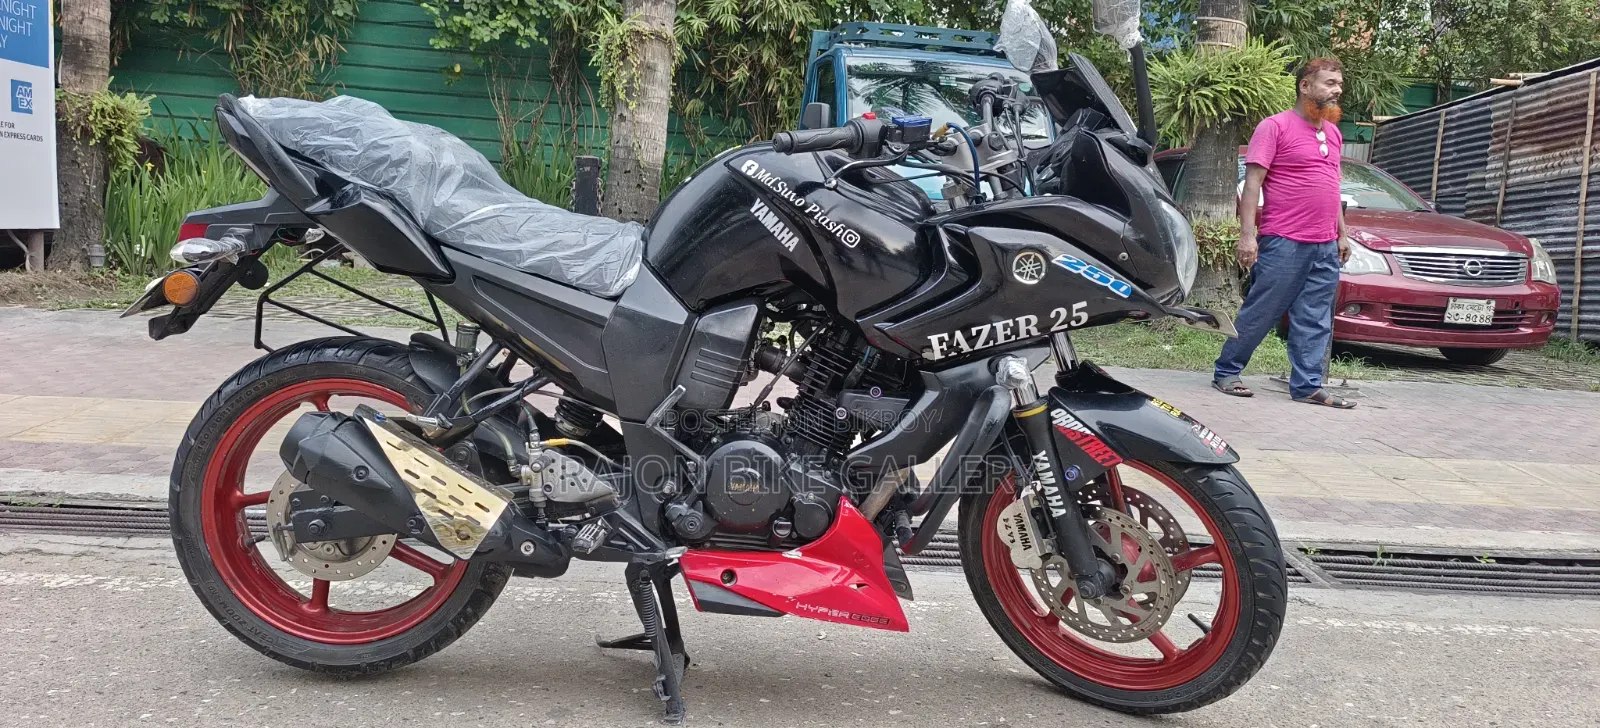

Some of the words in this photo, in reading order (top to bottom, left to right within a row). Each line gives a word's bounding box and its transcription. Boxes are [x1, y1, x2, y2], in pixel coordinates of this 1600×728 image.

[0, 0, 37, 19] NIGHT
[4, 131, 26, 140] EXPRESS
[26, 134, 43, 142] CARDS
[5, 121, 15, 129] FOR
[749, 197, 800, 253] YAMAHA
[804, 202, 846, 237] Piash
[1051, 254, 1132, 299] 250
[927, 314, 1041, 362] FAZER
[1050, 301, 1089, 332] 25
[1033, 450, 1067, 518] YAMAHA
[1013, 512, 1032, 551] YAMAHA
